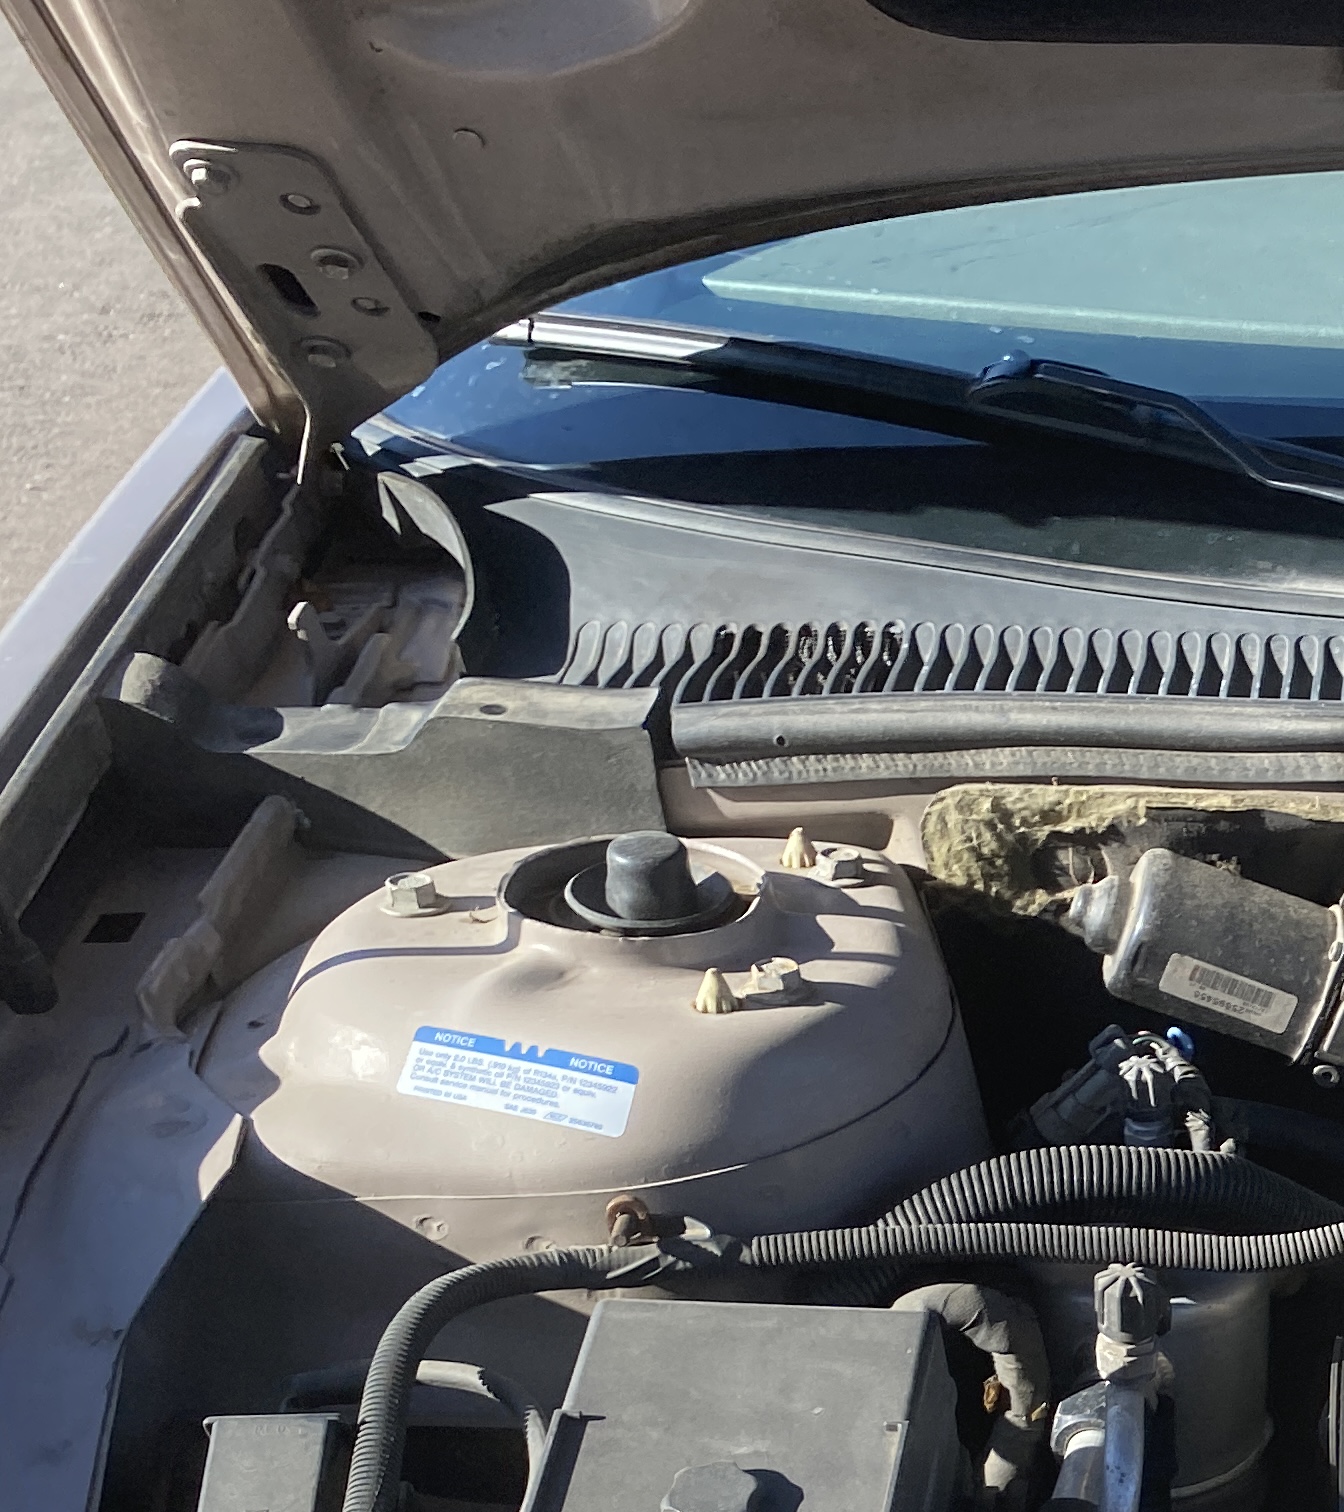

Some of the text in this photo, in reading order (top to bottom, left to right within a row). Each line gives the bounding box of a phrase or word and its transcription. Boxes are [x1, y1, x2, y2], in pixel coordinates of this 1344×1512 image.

[435, 1032, 476, 1047] NOTICE
[570, 1057, 614, 1075] NOTICE
[443, 1070, 476, 1082] SYSTEM
